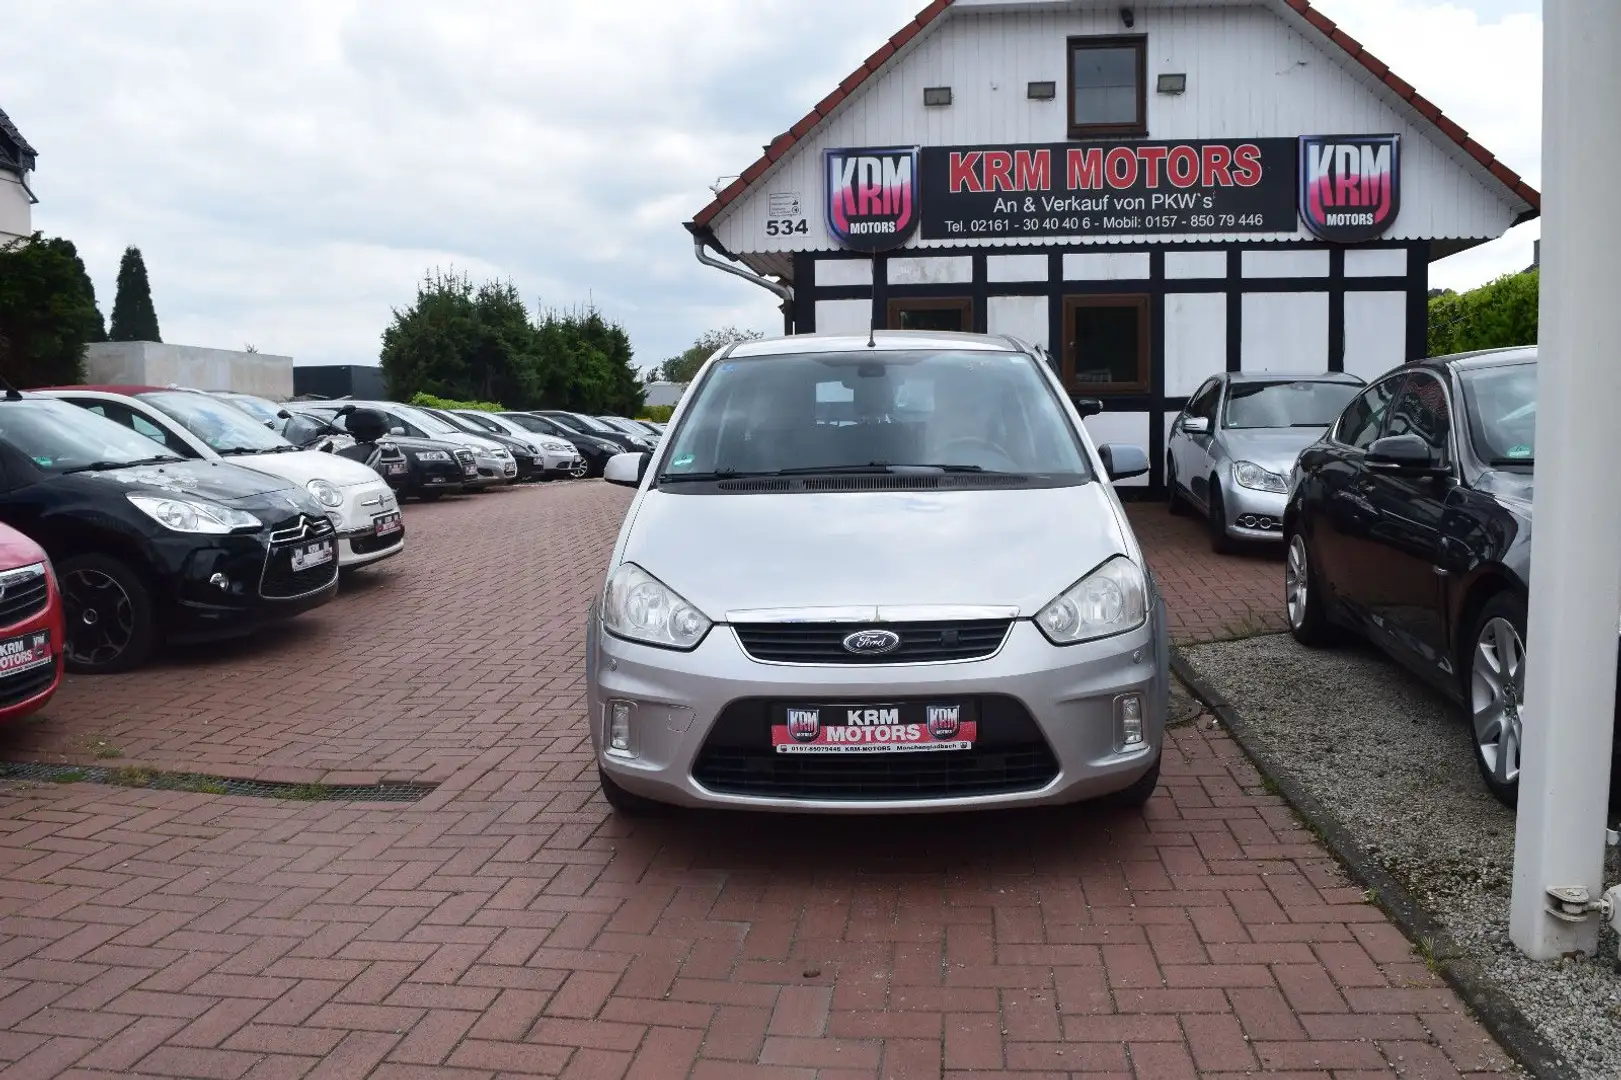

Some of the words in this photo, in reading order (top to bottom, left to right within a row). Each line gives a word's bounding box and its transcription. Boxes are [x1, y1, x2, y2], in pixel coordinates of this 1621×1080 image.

[949, 149, 1051, 193] KRM
[1066, 143, 1263, 190] MOTORS
[1308, 144, 1391, 224] KRM
[832, 156, 911, 233] KRM
[993, 197, 1017, 213] An
[1023, 196, 1036, 213] &
[1041, 194, 1110, 212] Verkauf
[1114, 198, 1145, 211] von
[766, 219, 809, 236] 534
[850, 221, 896, 235] MOTORS
[945, 220, 967, 233] Tel.
[970, 218, 1009, 232] 02161
[1023, 217, 1039, 231] 30
[1042, 216, 1059, 230] 40
[1062, 216, 1079, 230] 40
[1082, 216, 1091, 229] 6
[1103, 216, 1142, 229] Mobil:
[1145, 215, 1178, 228] 0157
[1190, 215, 1215, 227] 850
[1218, 214, 1235, 227] 79
[1238, 213, 1263, 226] 446
[1326, 212, 1374, 226] MOTORS
[856, 634, 887, 648] Ford
[0, 649, 33, 669] OTORS
[847, 708, 899, 726] KRM
[827, 724, 921, 742] MOTORS
